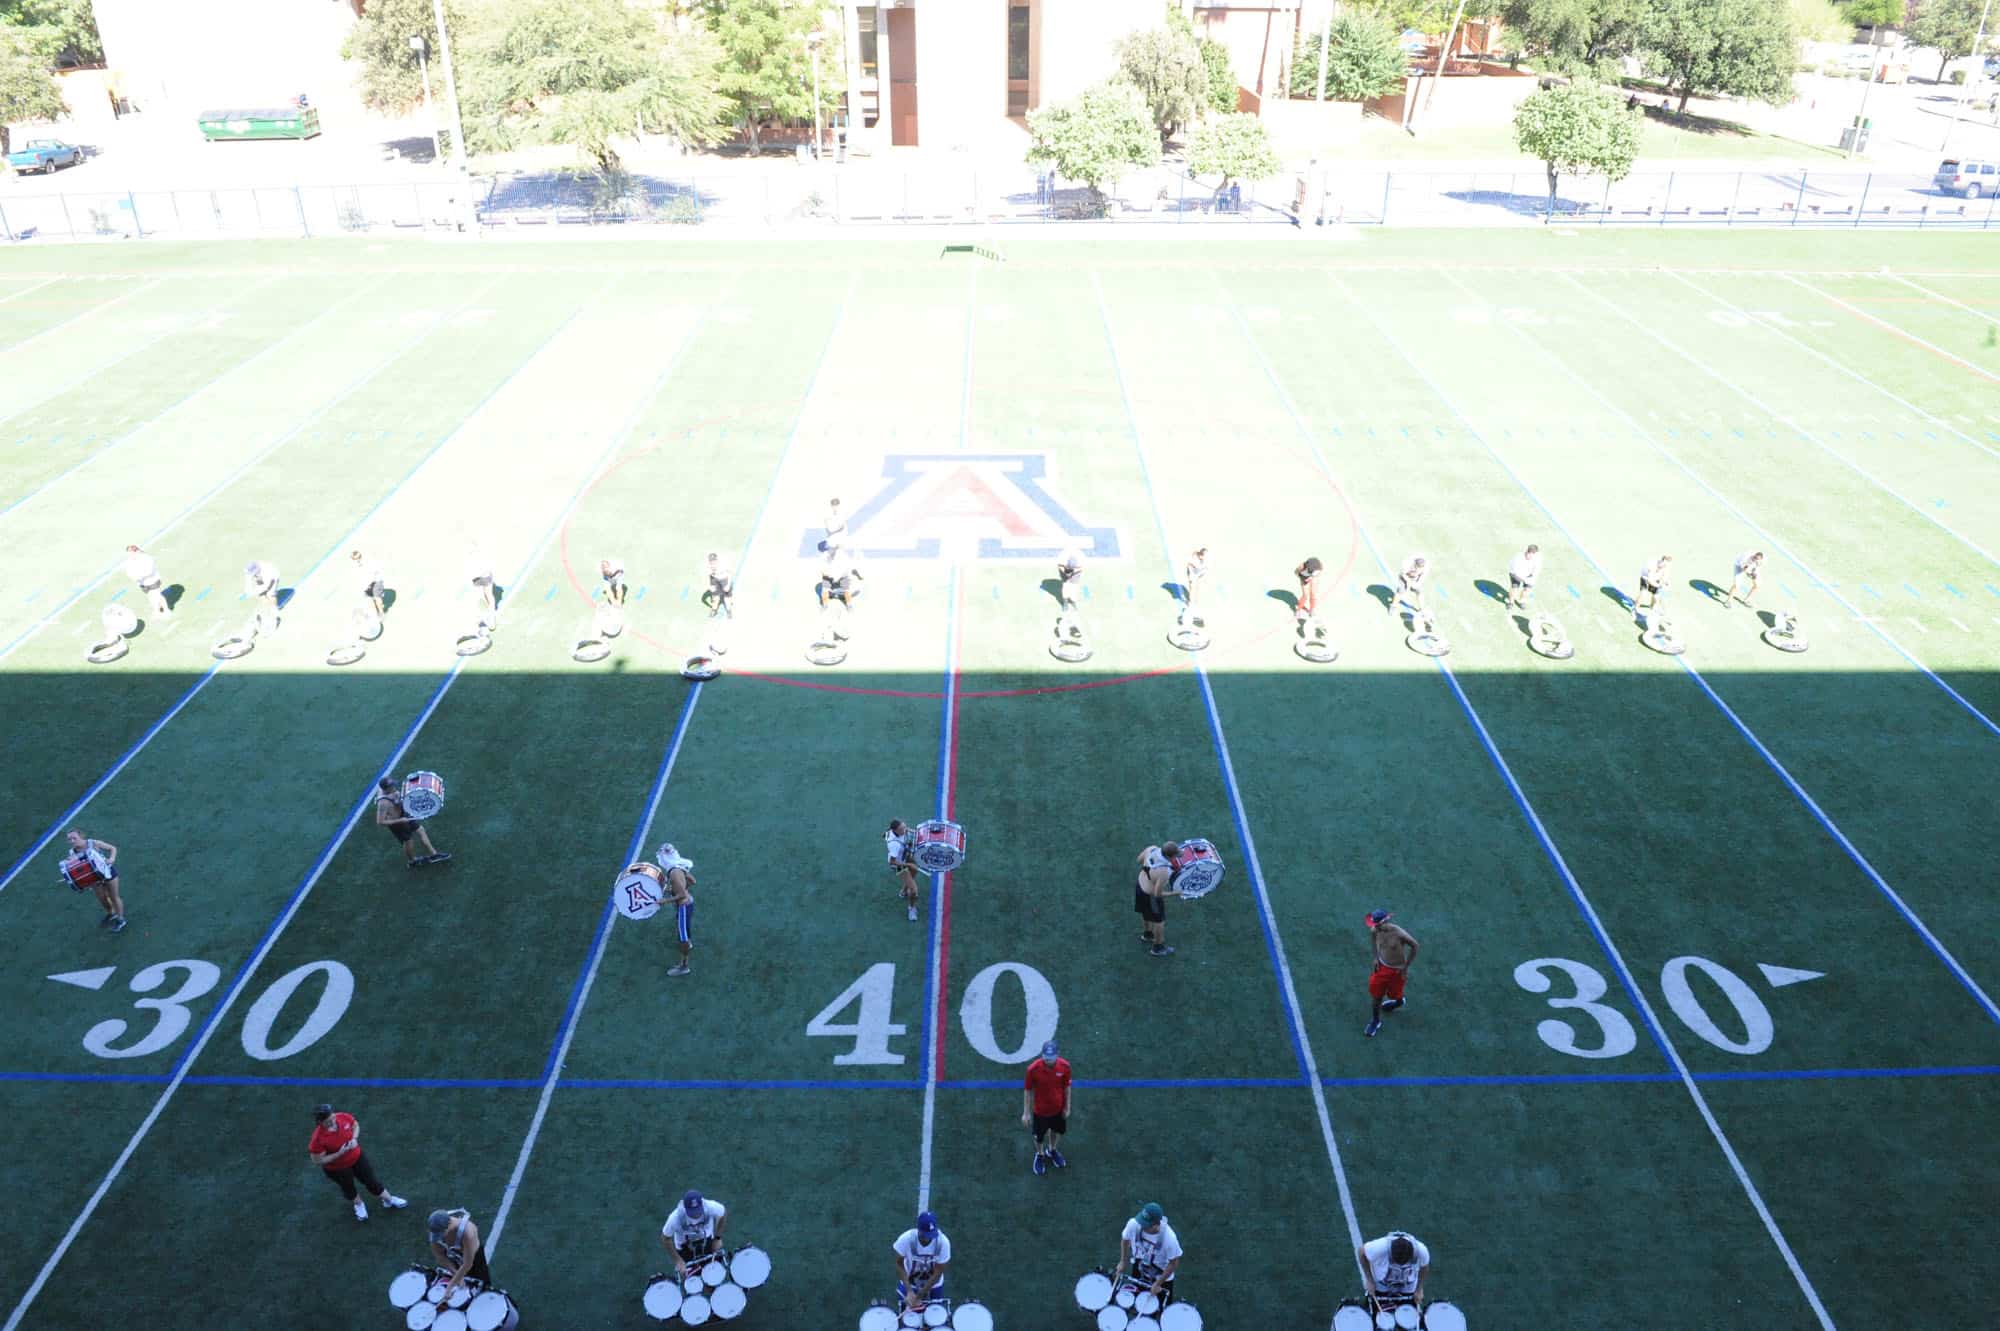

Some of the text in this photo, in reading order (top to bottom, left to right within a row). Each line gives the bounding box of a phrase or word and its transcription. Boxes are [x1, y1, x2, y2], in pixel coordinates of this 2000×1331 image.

[797, 452, 1123, 560] A
[625, 881, 658, 913] A
[83, 959, 354, 1060] 30
[807, 962, 1059, 1064] 40
[1514, 957, 1774, 1058] 30
